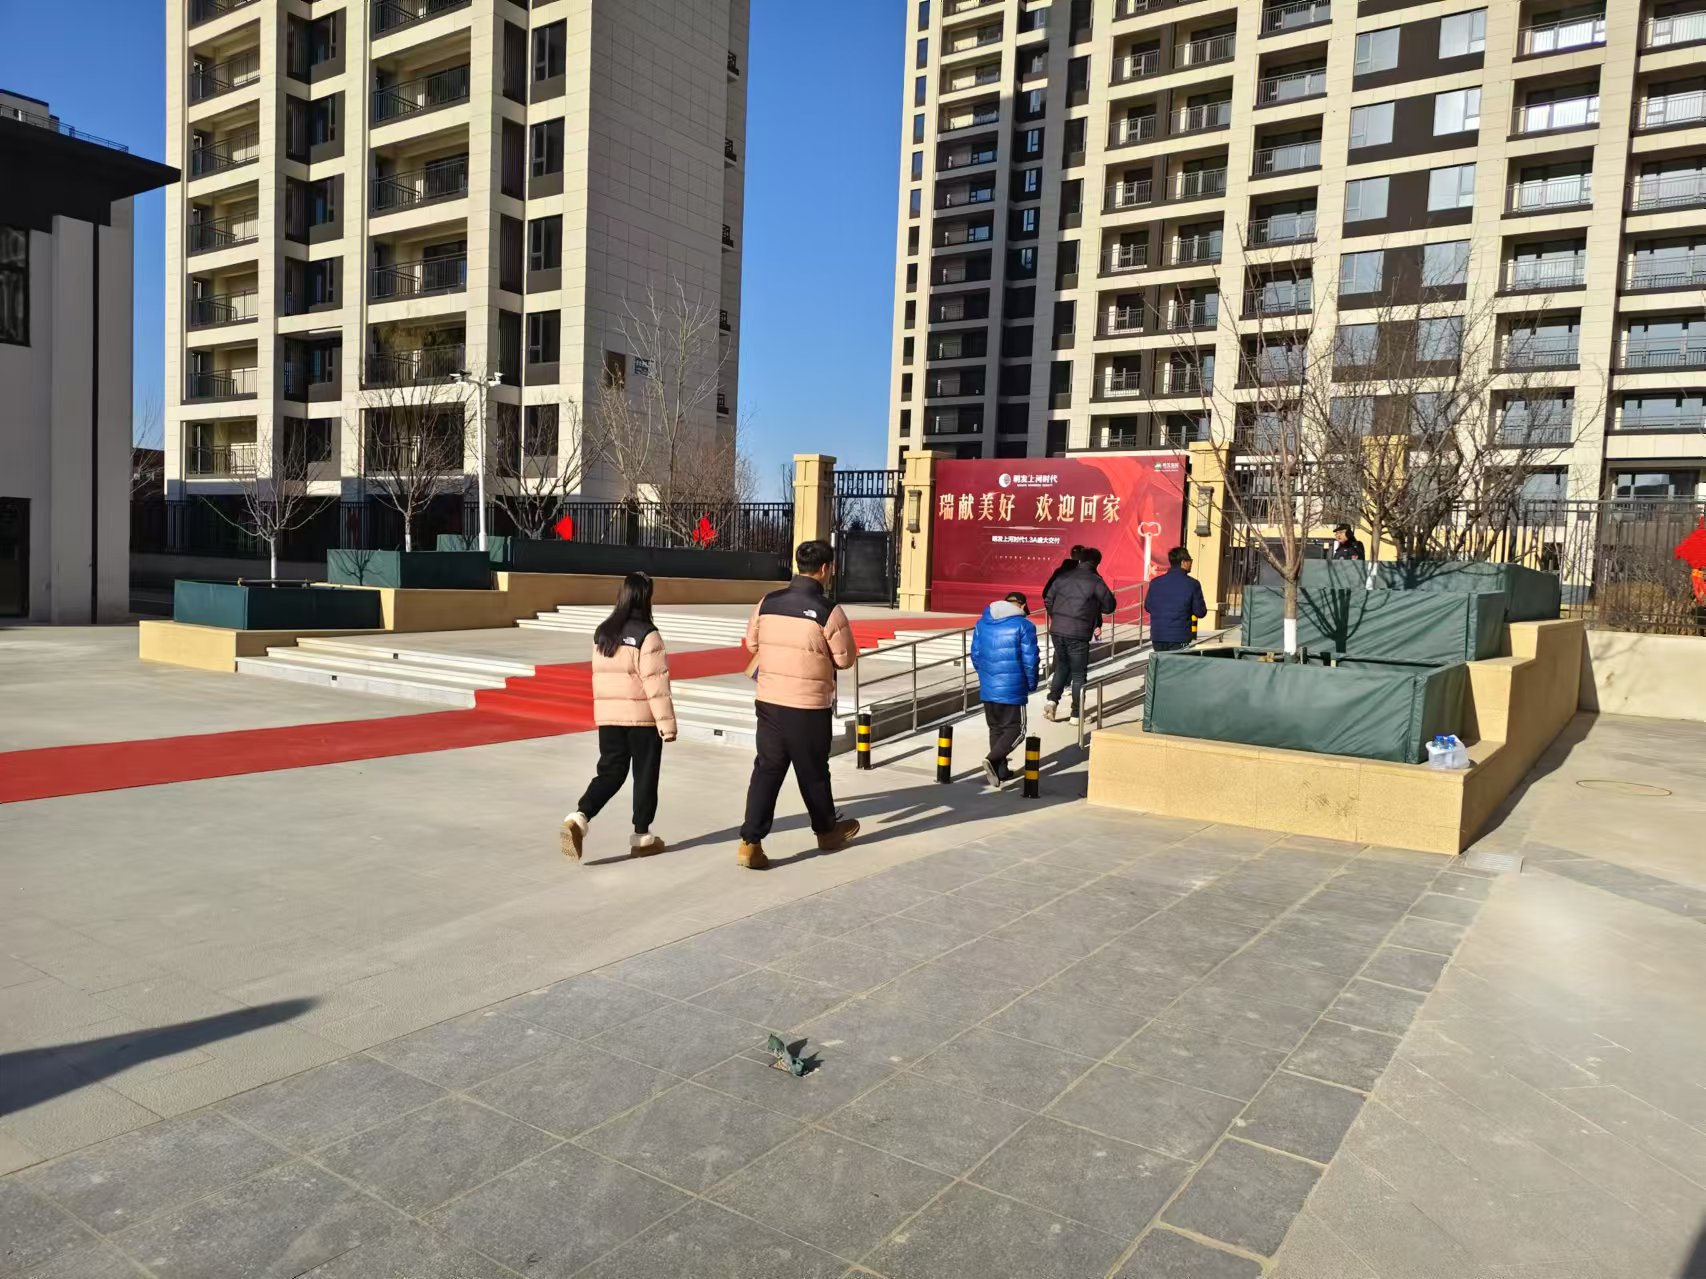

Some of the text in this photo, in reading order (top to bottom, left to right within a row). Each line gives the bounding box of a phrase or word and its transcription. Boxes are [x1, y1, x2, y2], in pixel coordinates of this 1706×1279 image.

[939, 493, 1121, 523] 瑞献美好 欢迎回家
